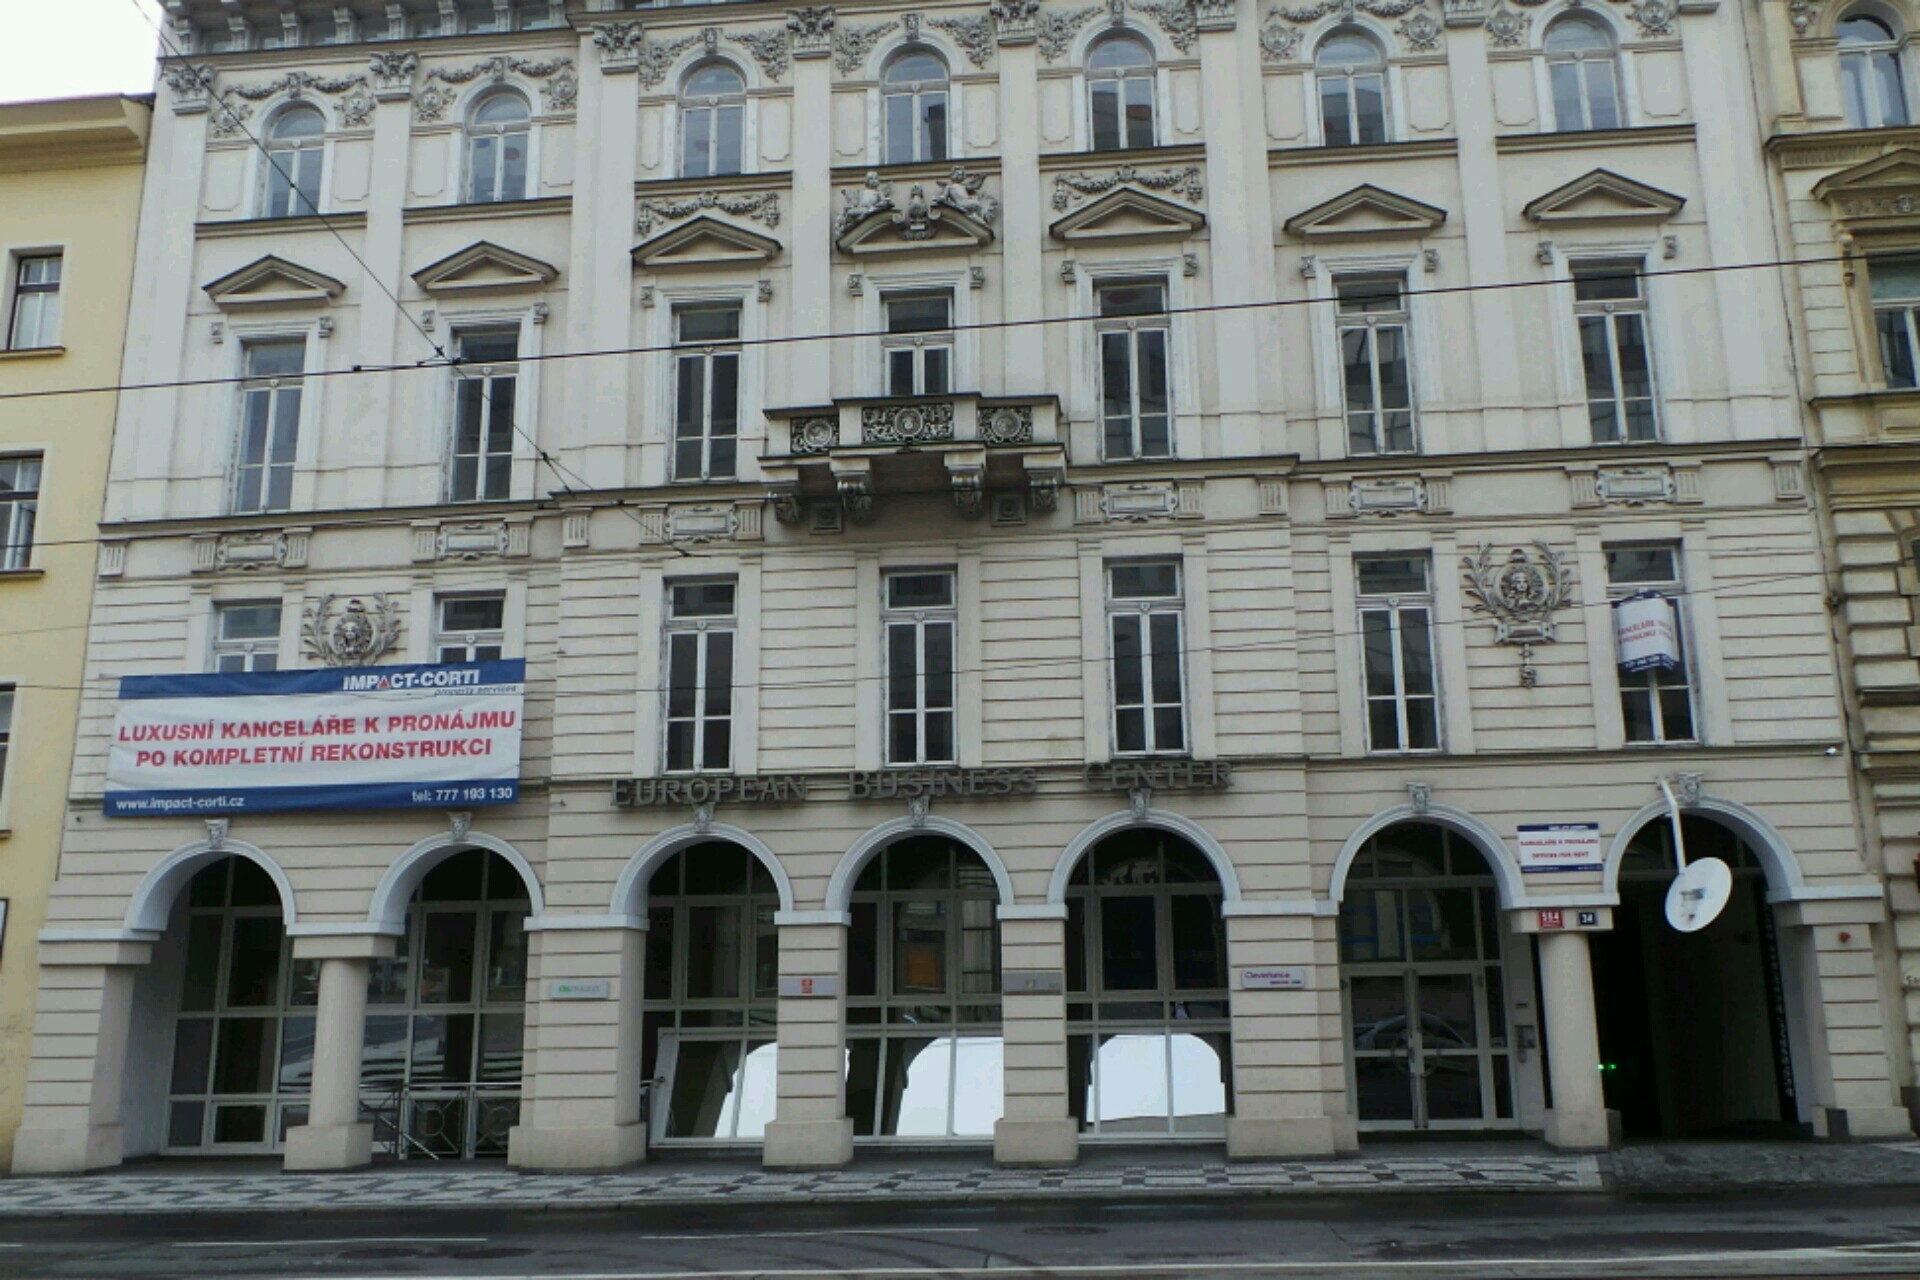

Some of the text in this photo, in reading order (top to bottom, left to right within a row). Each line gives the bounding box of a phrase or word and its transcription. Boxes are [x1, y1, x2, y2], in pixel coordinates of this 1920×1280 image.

[342, 669, 481, 690] IMPACT-CORTI
[118, 709, 516, 742] LUXUSNÍ KANCELÁŘE K PRONÁJMU
[136, 738, 492, 768] PO KOMPLETNÍ REKONSTRUKCI
[610, 761, 1235, 806] EUROPEAN BUSINESS CENTER
[116, 796, 246, 810] www.impact-corti.cz
[435, 788, 459, 801] 777
[463, 787, 485, 800] 193
[489, 786, 513, 799] 130
[1581, 913, 1593, 923] 34
